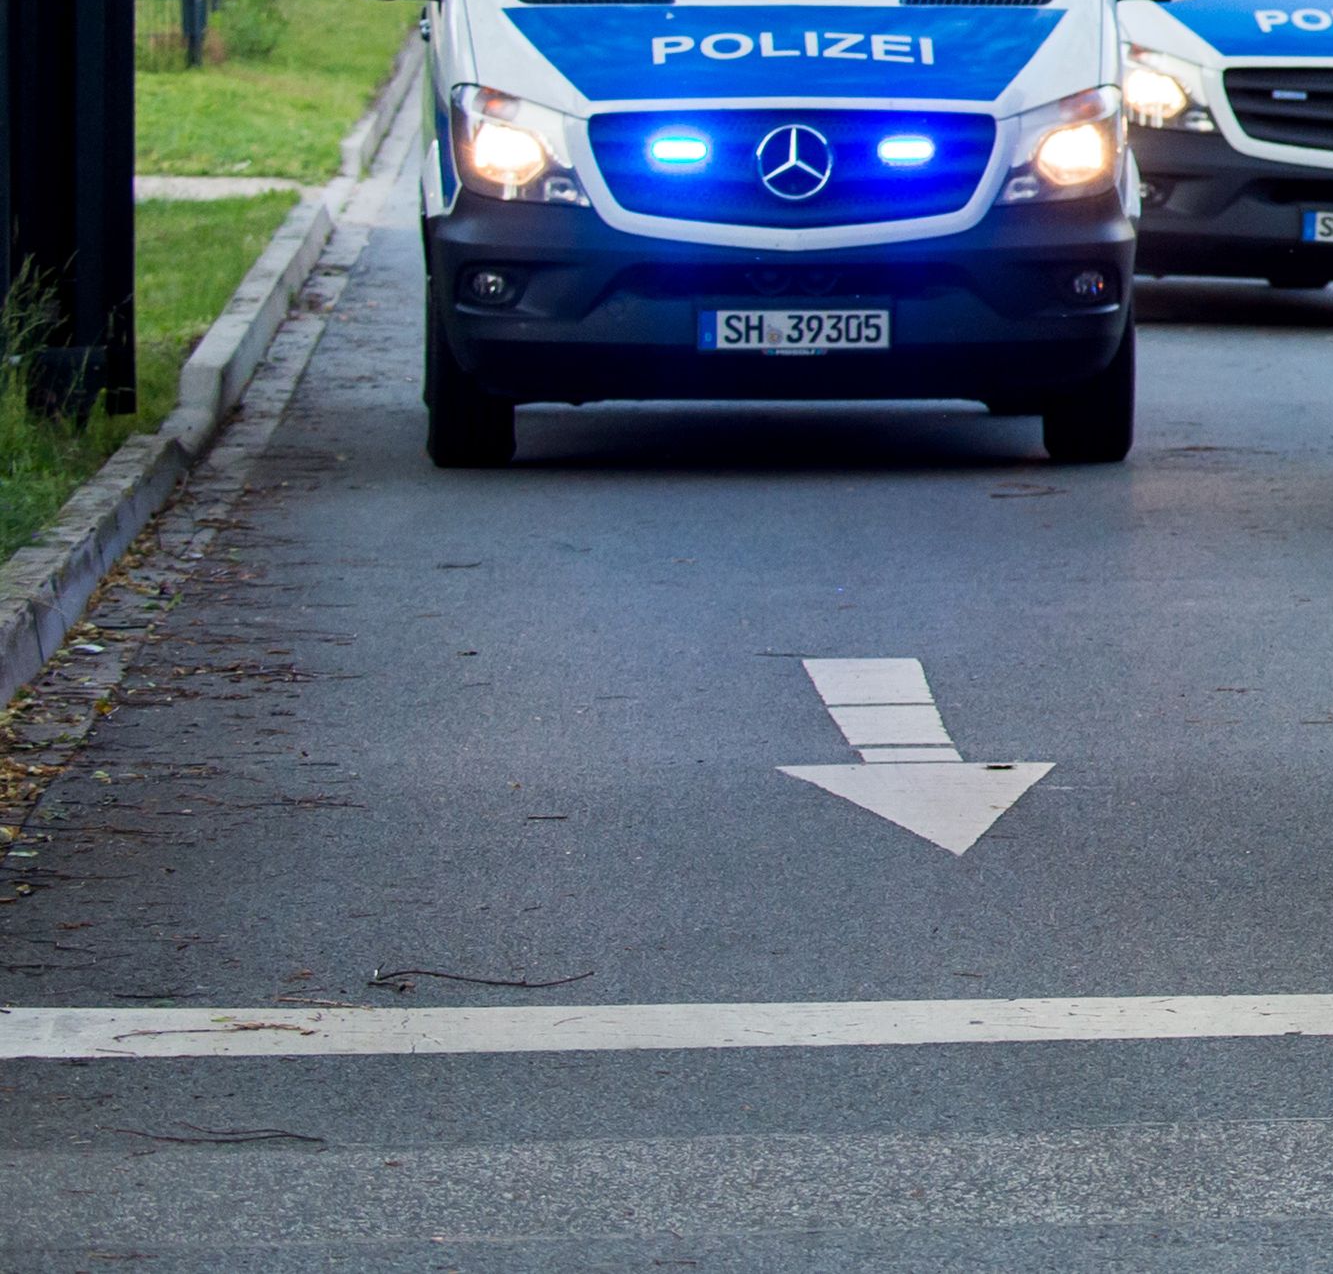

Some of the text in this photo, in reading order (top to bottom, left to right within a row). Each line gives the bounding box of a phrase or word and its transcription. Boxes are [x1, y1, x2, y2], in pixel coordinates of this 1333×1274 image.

[651, 31, 935, 65] POLIZEI
[724, 314, 882, 344] SH 39305
